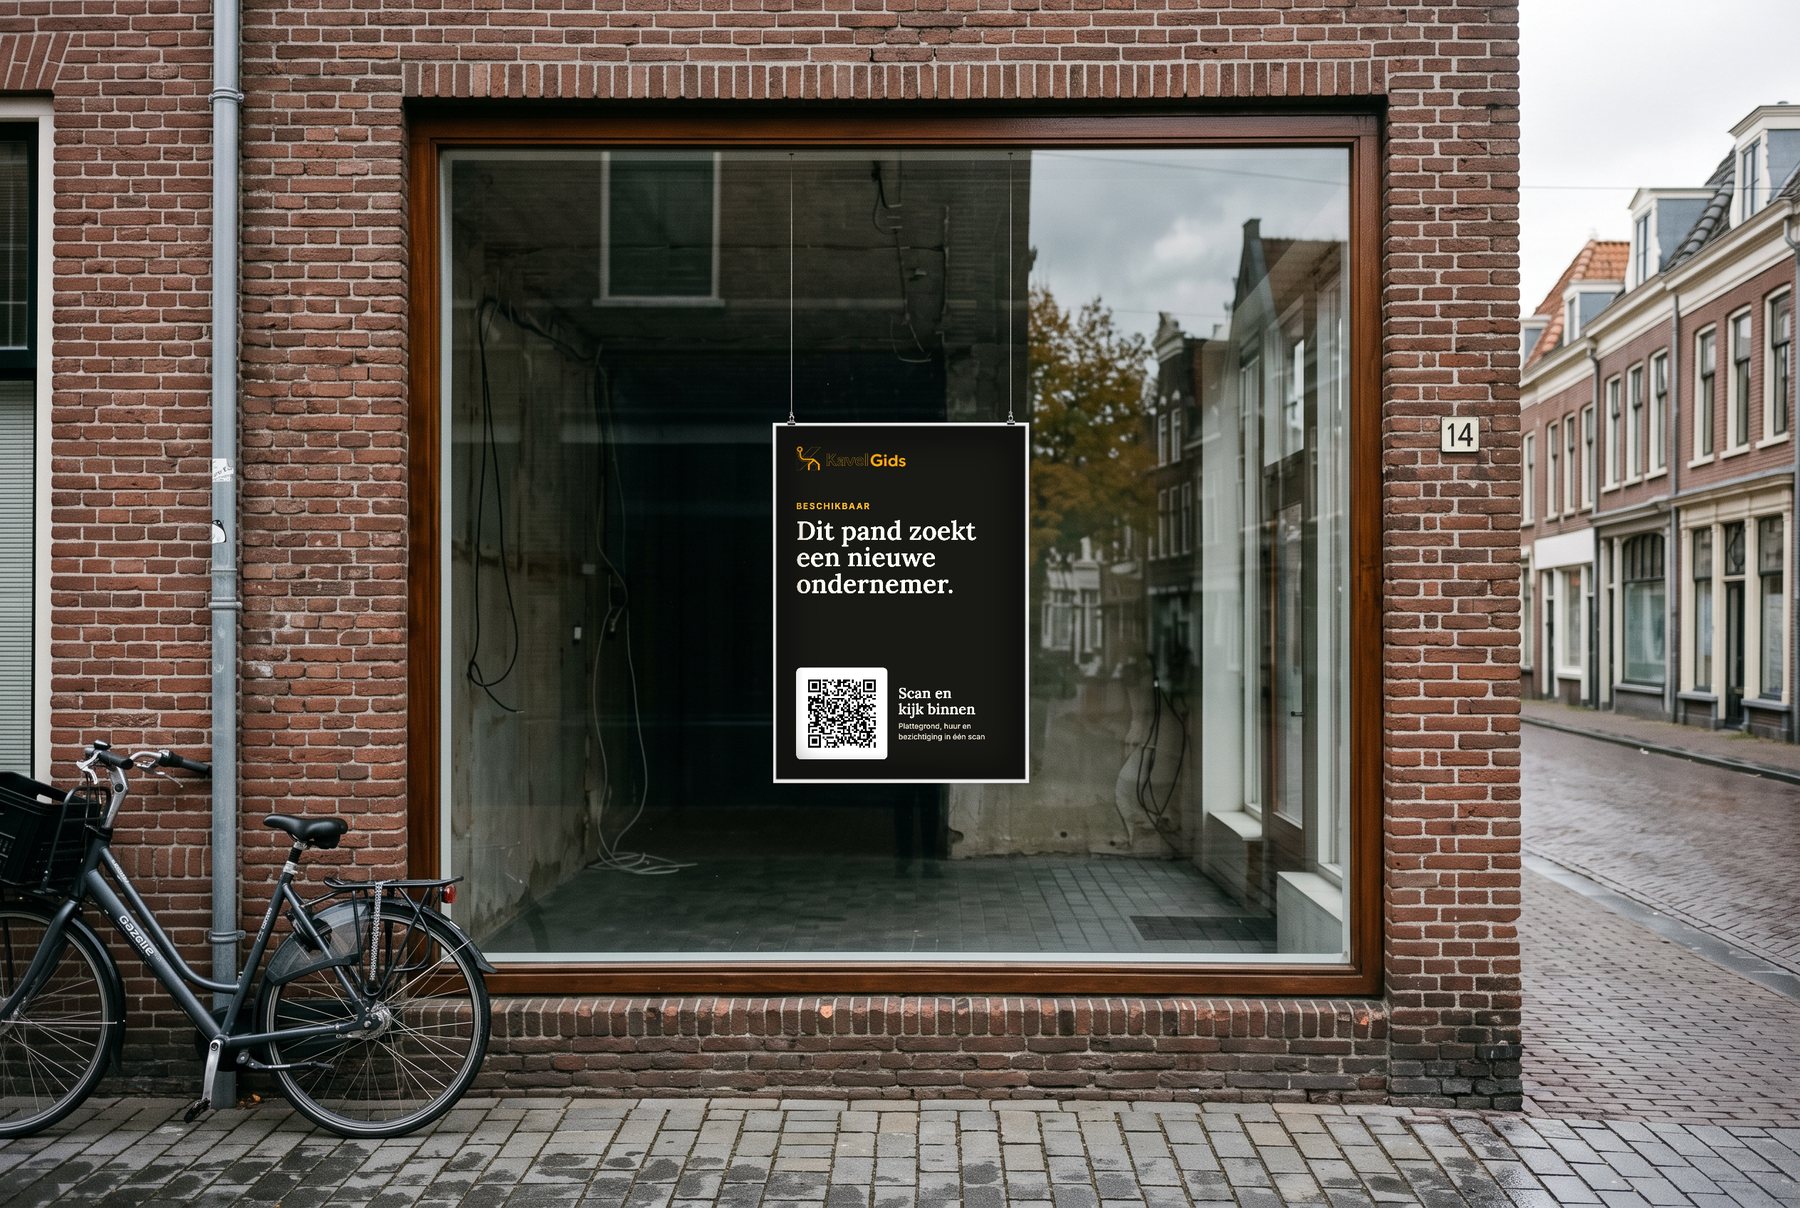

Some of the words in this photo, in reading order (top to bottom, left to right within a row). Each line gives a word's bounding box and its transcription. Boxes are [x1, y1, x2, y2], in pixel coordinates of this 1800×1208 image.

[1447, 422, 1473, 447] 14
[796, 502, 871, 511] BESCHIKBAAR
[796, 520, 835, 541] Dit
[841, 520, 902, 547] pand
[909, 520, 976, 541] zoekt
[796, 551, 840, 567] een
[847, 547, 936, 567] nieuwe
[796, 573, 954, 594] ondernemer.
[898, 687, 931, 699] Scan
[935, 690, 952, 699] en
[898, 703, 924, 719] kijk
[927, 703, 976, 715] binnen
[898, 723, 942, 731] Plattegrond,
[898, 733, 942, 741] bezichtiging
